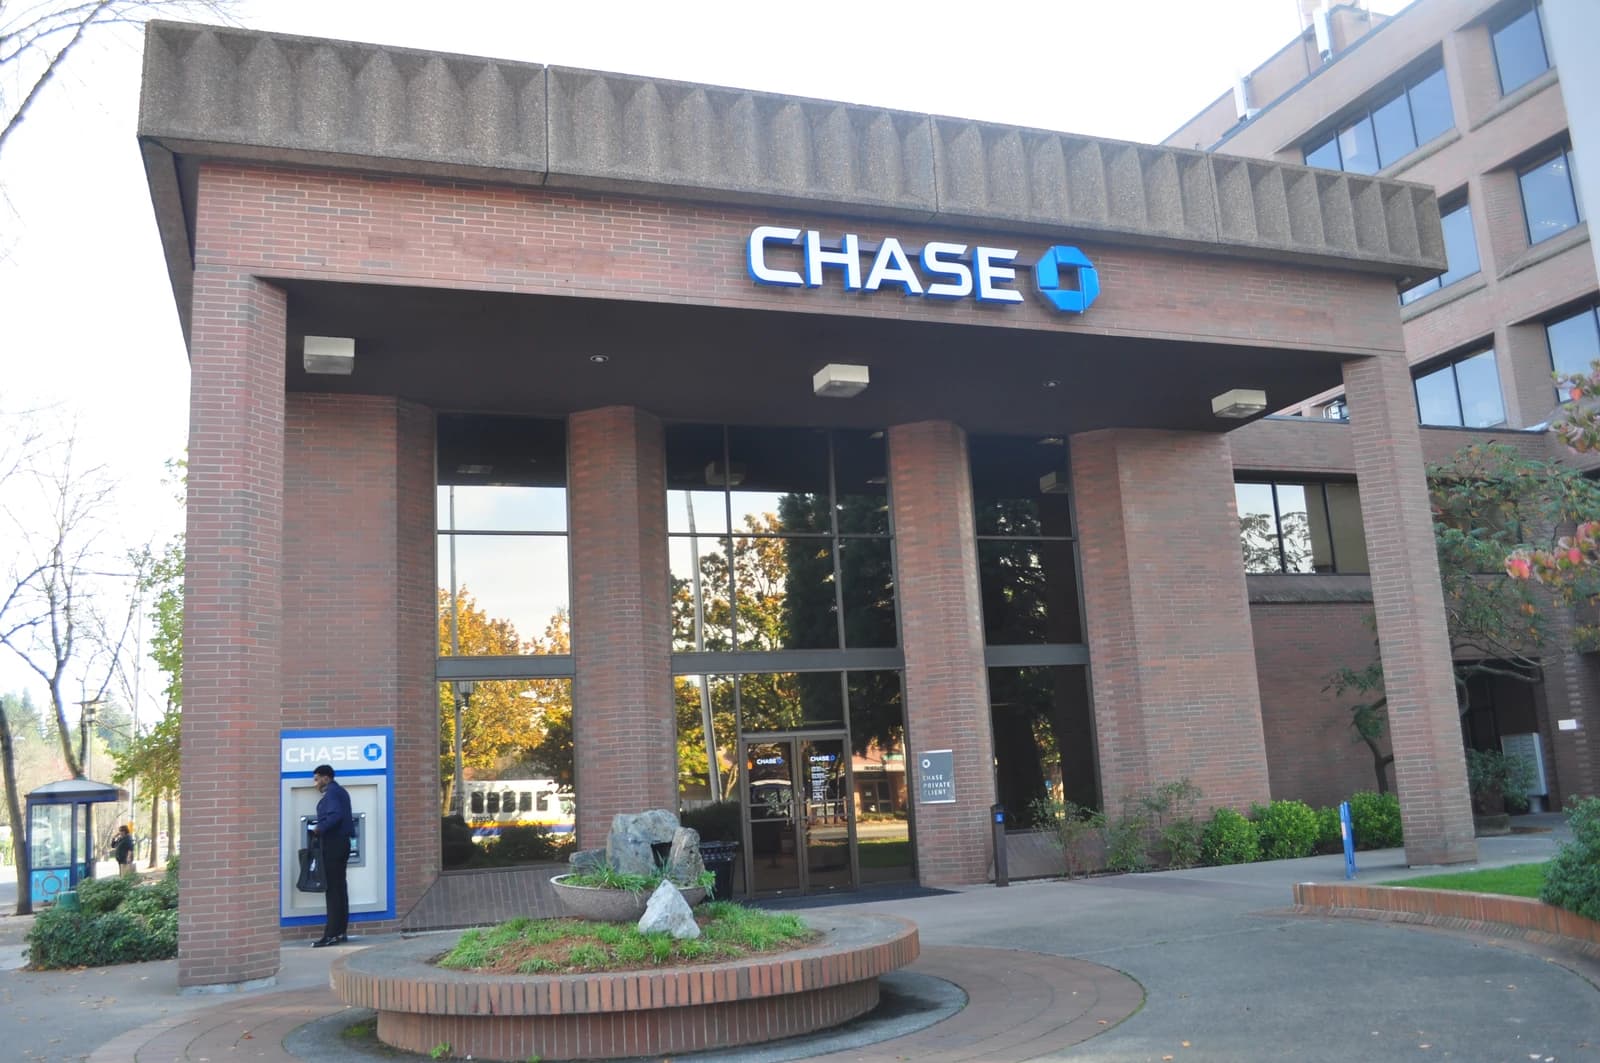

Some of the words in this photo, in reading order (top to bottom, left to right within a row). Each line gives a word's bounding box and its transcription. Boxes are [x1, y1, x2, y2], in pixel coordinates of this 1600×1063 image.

[748, 226, 1025, 303] CHASE
[286, 745, 361, 762] CHASE
[923, 781, 951, 789] PRIVATE
